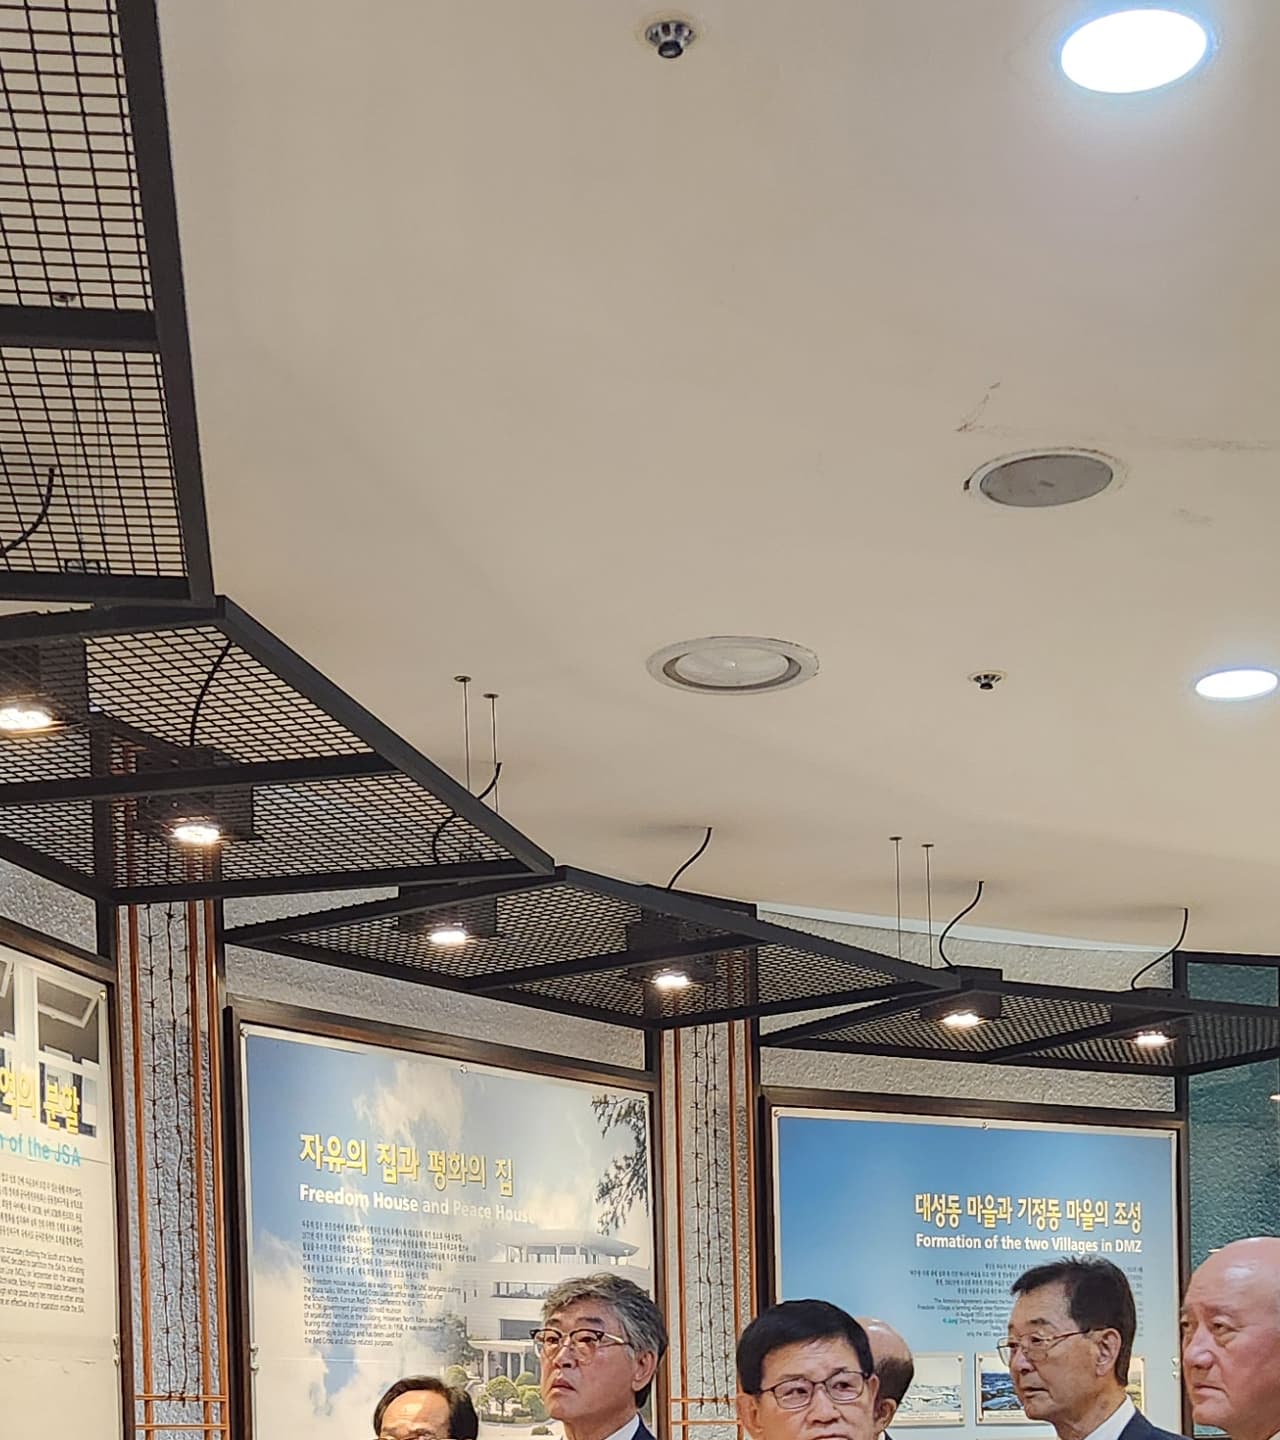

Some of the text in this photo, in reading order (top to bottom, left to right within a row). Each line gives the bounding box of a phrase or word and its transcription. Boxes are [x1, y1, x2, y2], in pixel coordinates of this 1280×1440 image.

[43, 1081, 80, 1135] 분할
[9, 1133, 23, 1153] of
[28, 1137, 50, 1160] the
[55, 1143, 81, 1167] JSA
[300, 1133, 513, 1197] 자유의 집과 평화의 집
[300, 1184, 369, 1208] Freedom
[373, 1192, 418, 1212] House
[423, 1197, 449, 1215] and
[453, 1201, 492, 1220] Peace
[915, 1193, 1142, 1234] 대성동 마을과 기정동 마을의 조성
[916, 1233, 1142, 1254] Formation of the two Villages in DMZ
